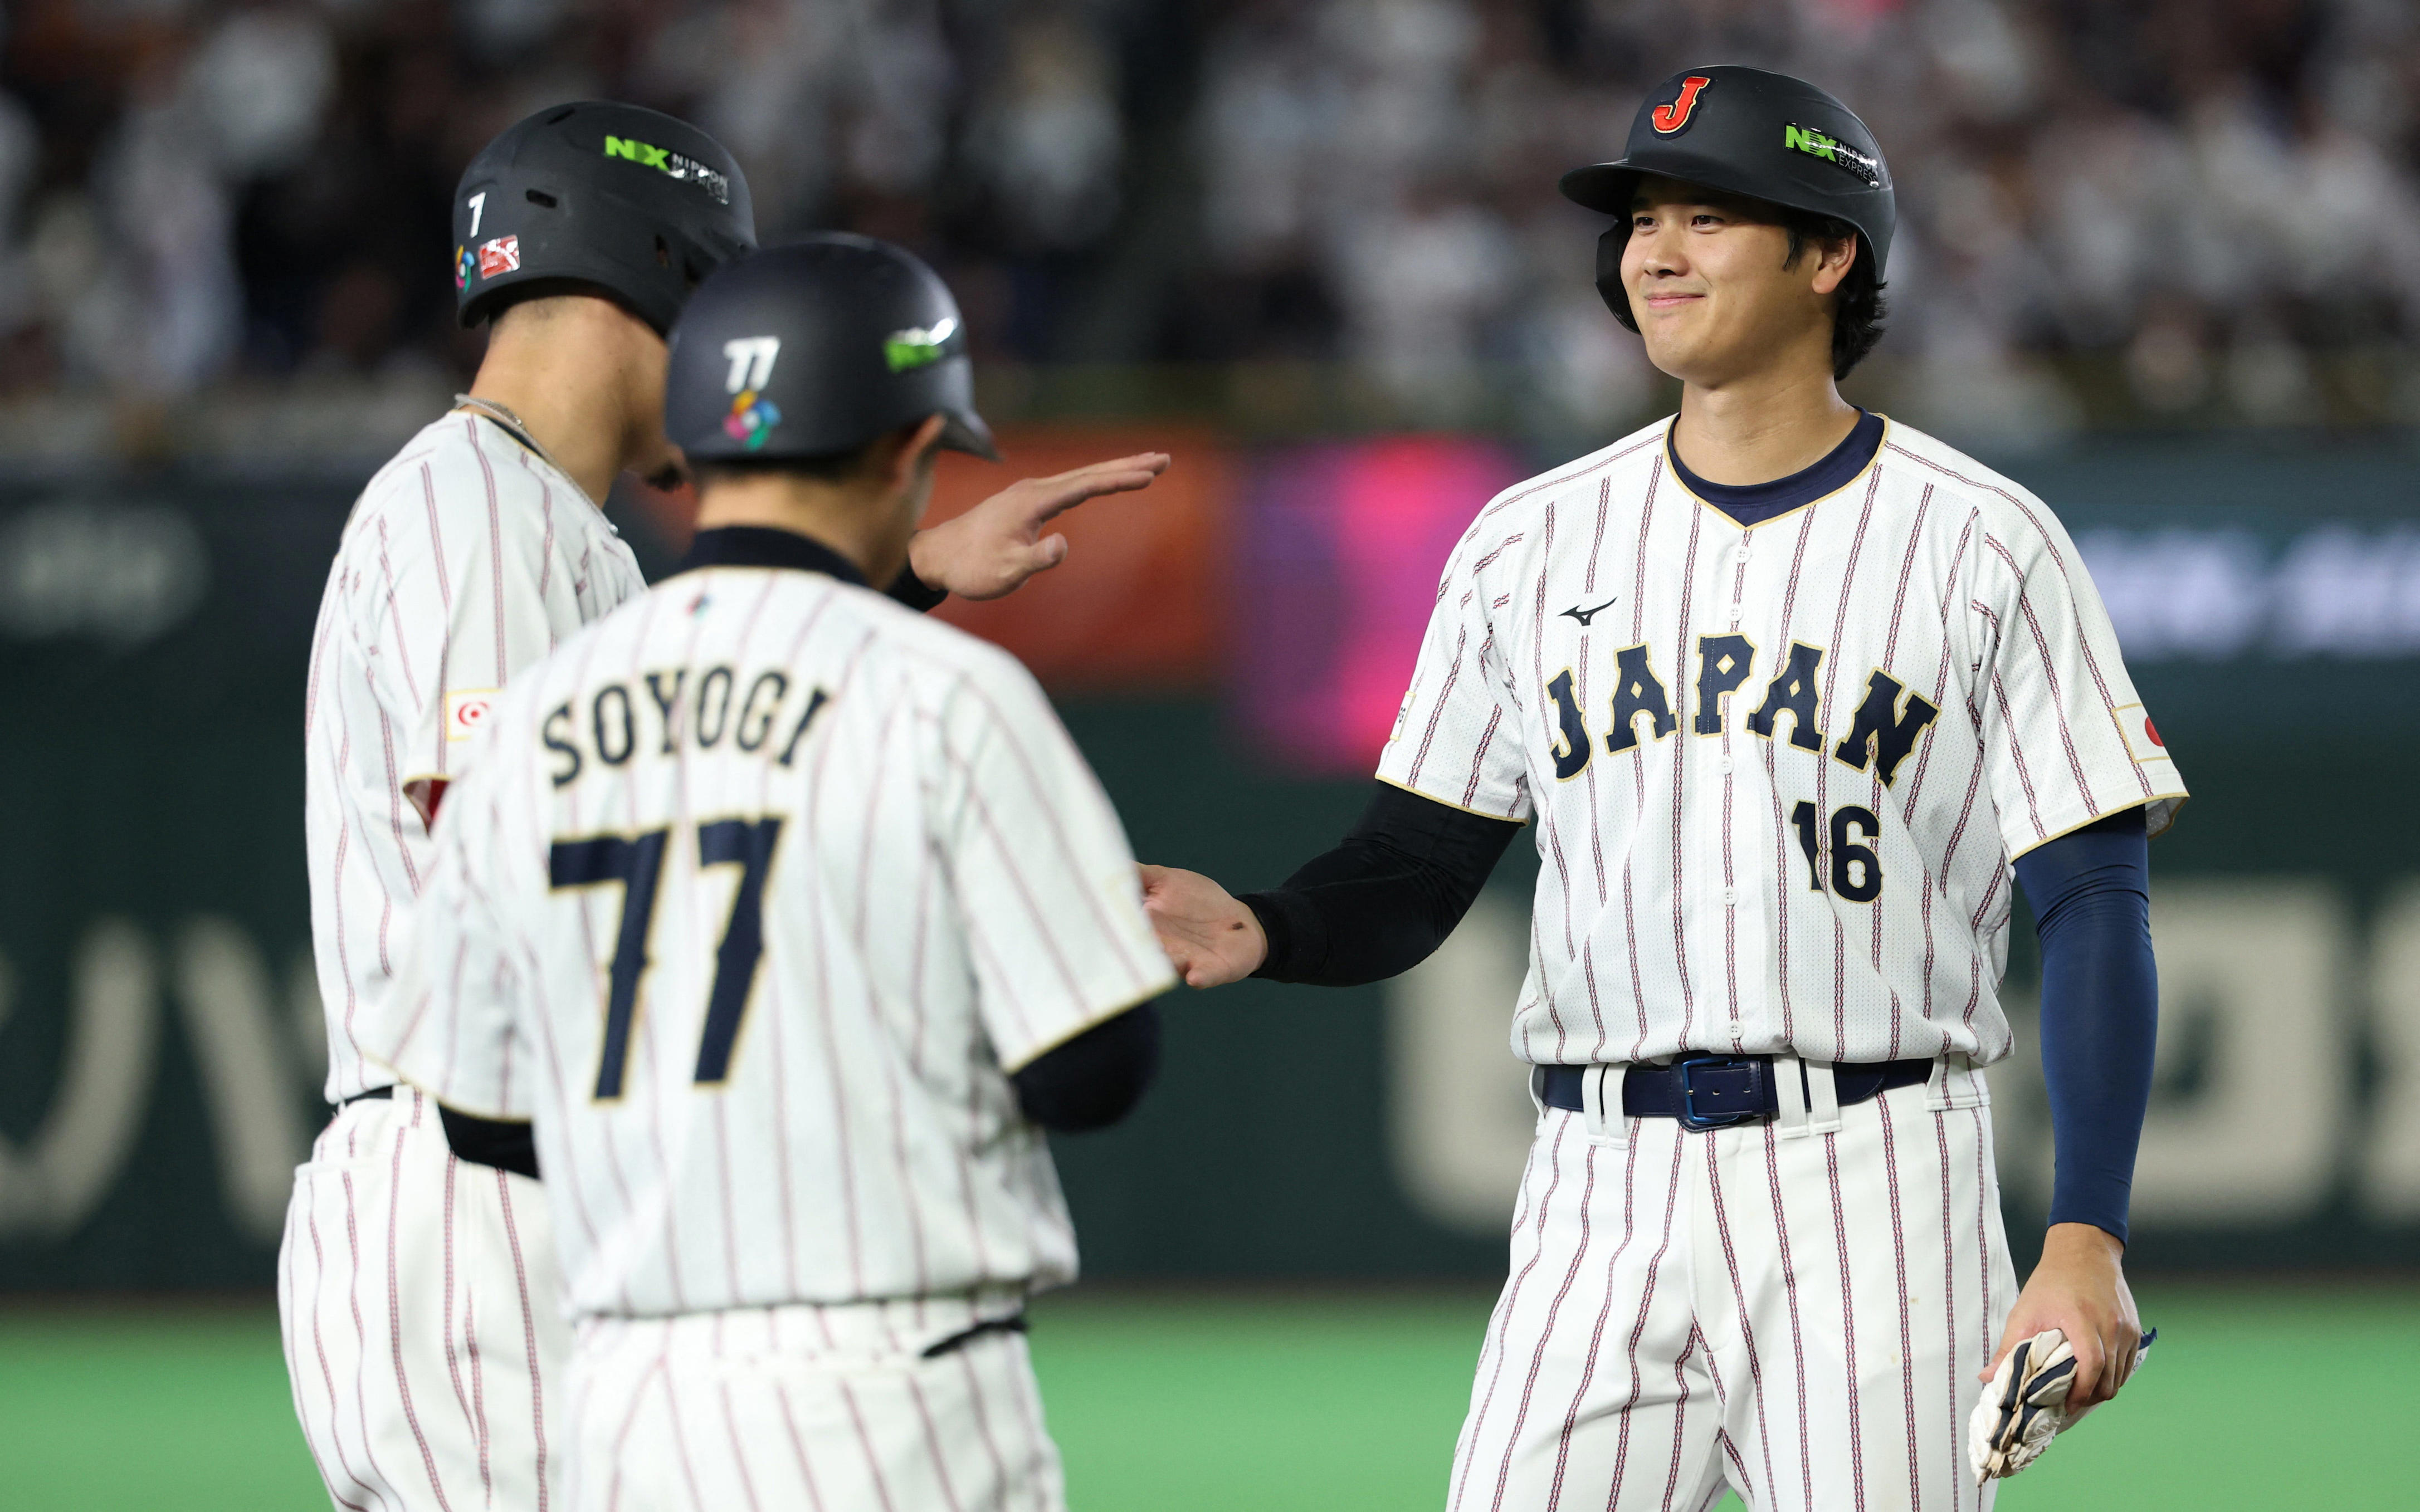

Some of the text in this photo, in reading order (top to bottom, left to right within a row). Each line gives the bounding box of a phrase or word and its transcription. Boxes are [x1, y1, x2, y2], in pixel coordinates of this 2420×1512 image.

[1652, 76, 1710, 134] J
[605, 135, 670, 171] NX
[1785, 125, 1837, 162] NX
[1839, 154, 1879, 187] EXPRESS
[469, 192, 486, 238] 7
[724, 336, 780, 394] 77
[541, 665, 830, 790] SOYOGI
[1545, 631, 1942, 790] JAPAN
[1791, 799, 1884, 904] 16
[549, 812, 789, 1103] 77
